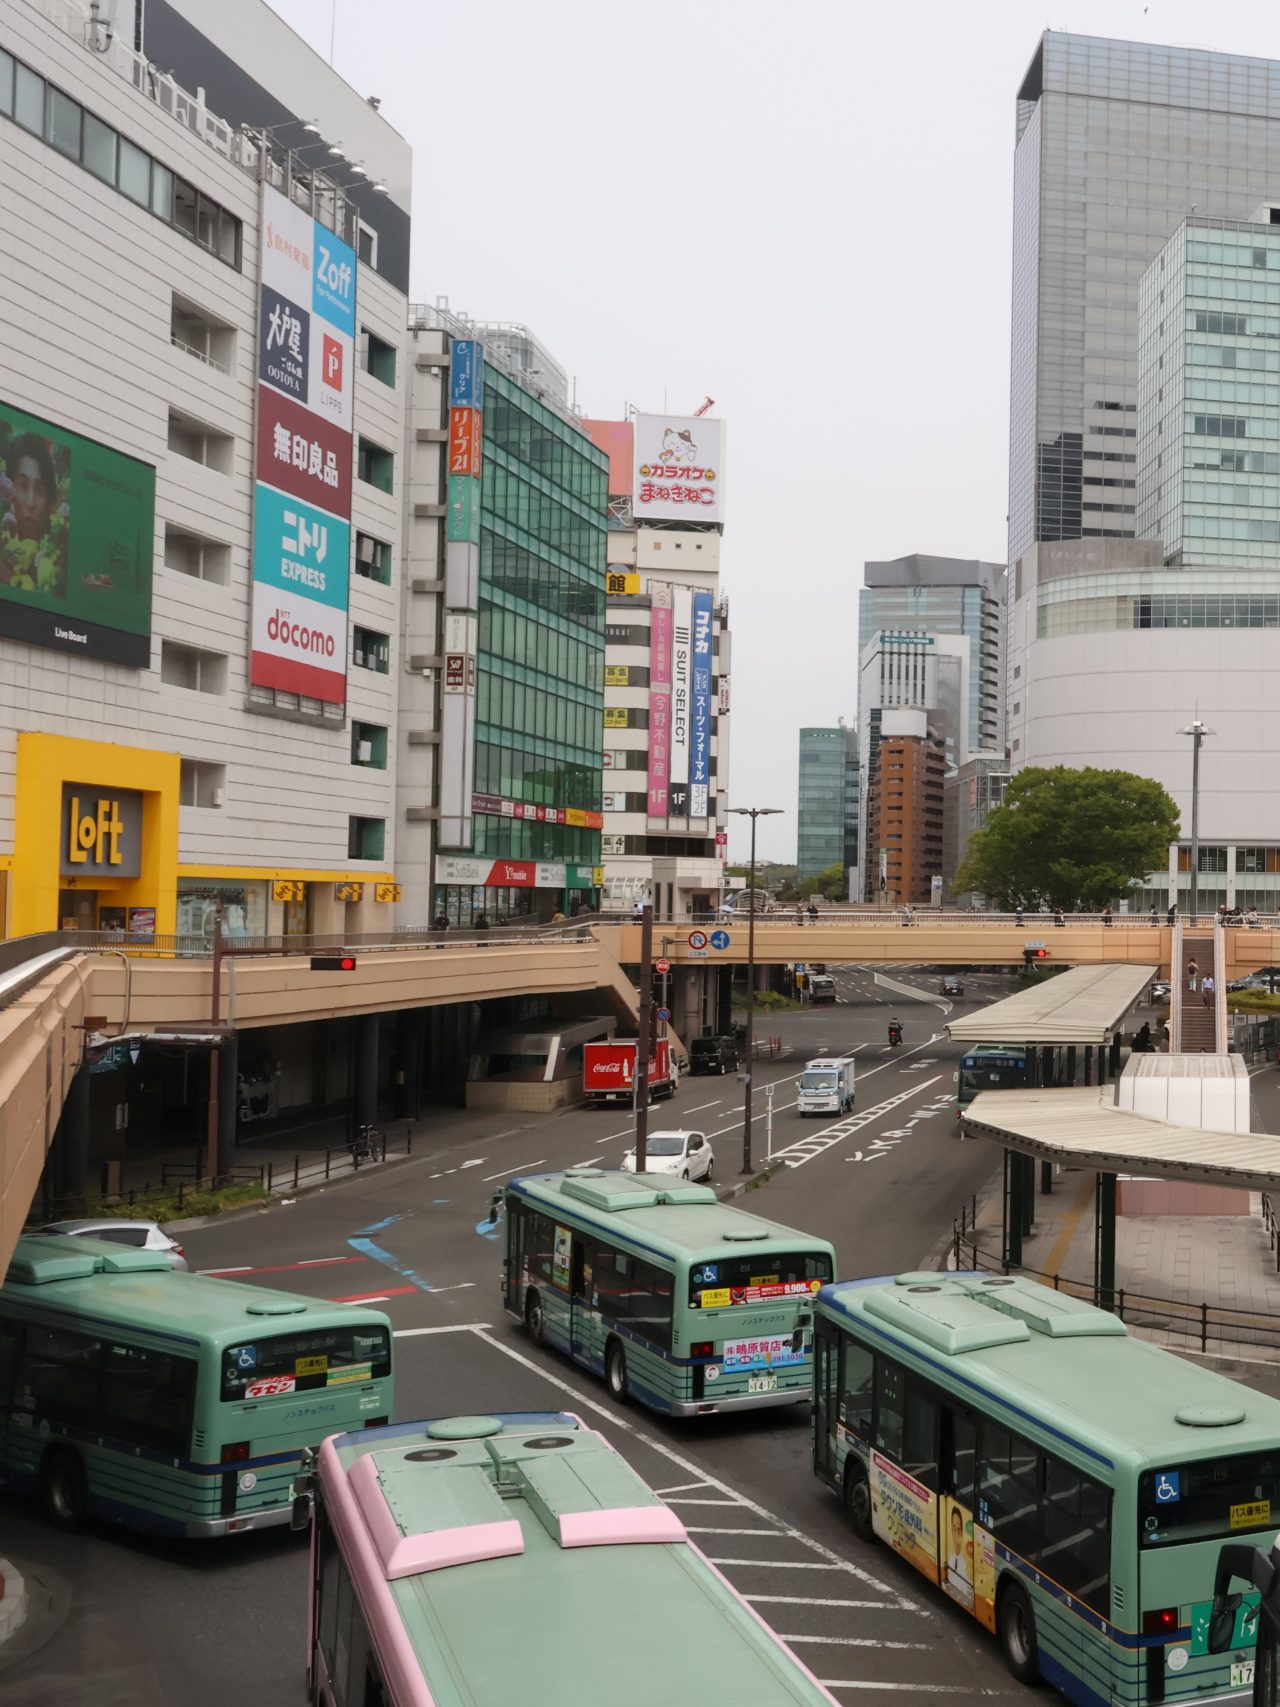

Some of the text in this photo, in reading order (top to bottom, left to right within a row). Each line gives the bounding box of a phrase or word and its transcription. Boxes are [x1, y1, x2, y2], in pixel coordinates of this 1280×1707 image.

[317, 245, 352, 299] Zoff
[268, 365, 301, 392] OOTOYA
[320, 391, 343, 414] LIPPS
[453, 411, 468, 472] リーブ21
[273, 422, 339, 489] 無印良品
[651, 465, 705, 481] カラオケ
[639, 481, 716, 506] まねきねこ
[281, 510, 328, 564] ニトリ
[281, 558, 326, 592] EXPRESS
[279, 609, 291, 620] NTT
[55, 627, 69, 639] Live
[267, 608, 336, 658] docomo
[695, 610, 711, 654] コナカ
[675, 649, 687, 747] SUIT SELECT
[695, 695, 706, 781] スーツ・フォーマル
[650, 788, 667, 804] 1F
[672, 792, 686, 805] 1F
[694, 785, 707, 799] 3F
[694, 801, 707, 814] 2F
[753, 1380, 777, 1391] 14-12
[1231, 1503, 1270, 1519] バス優先に
